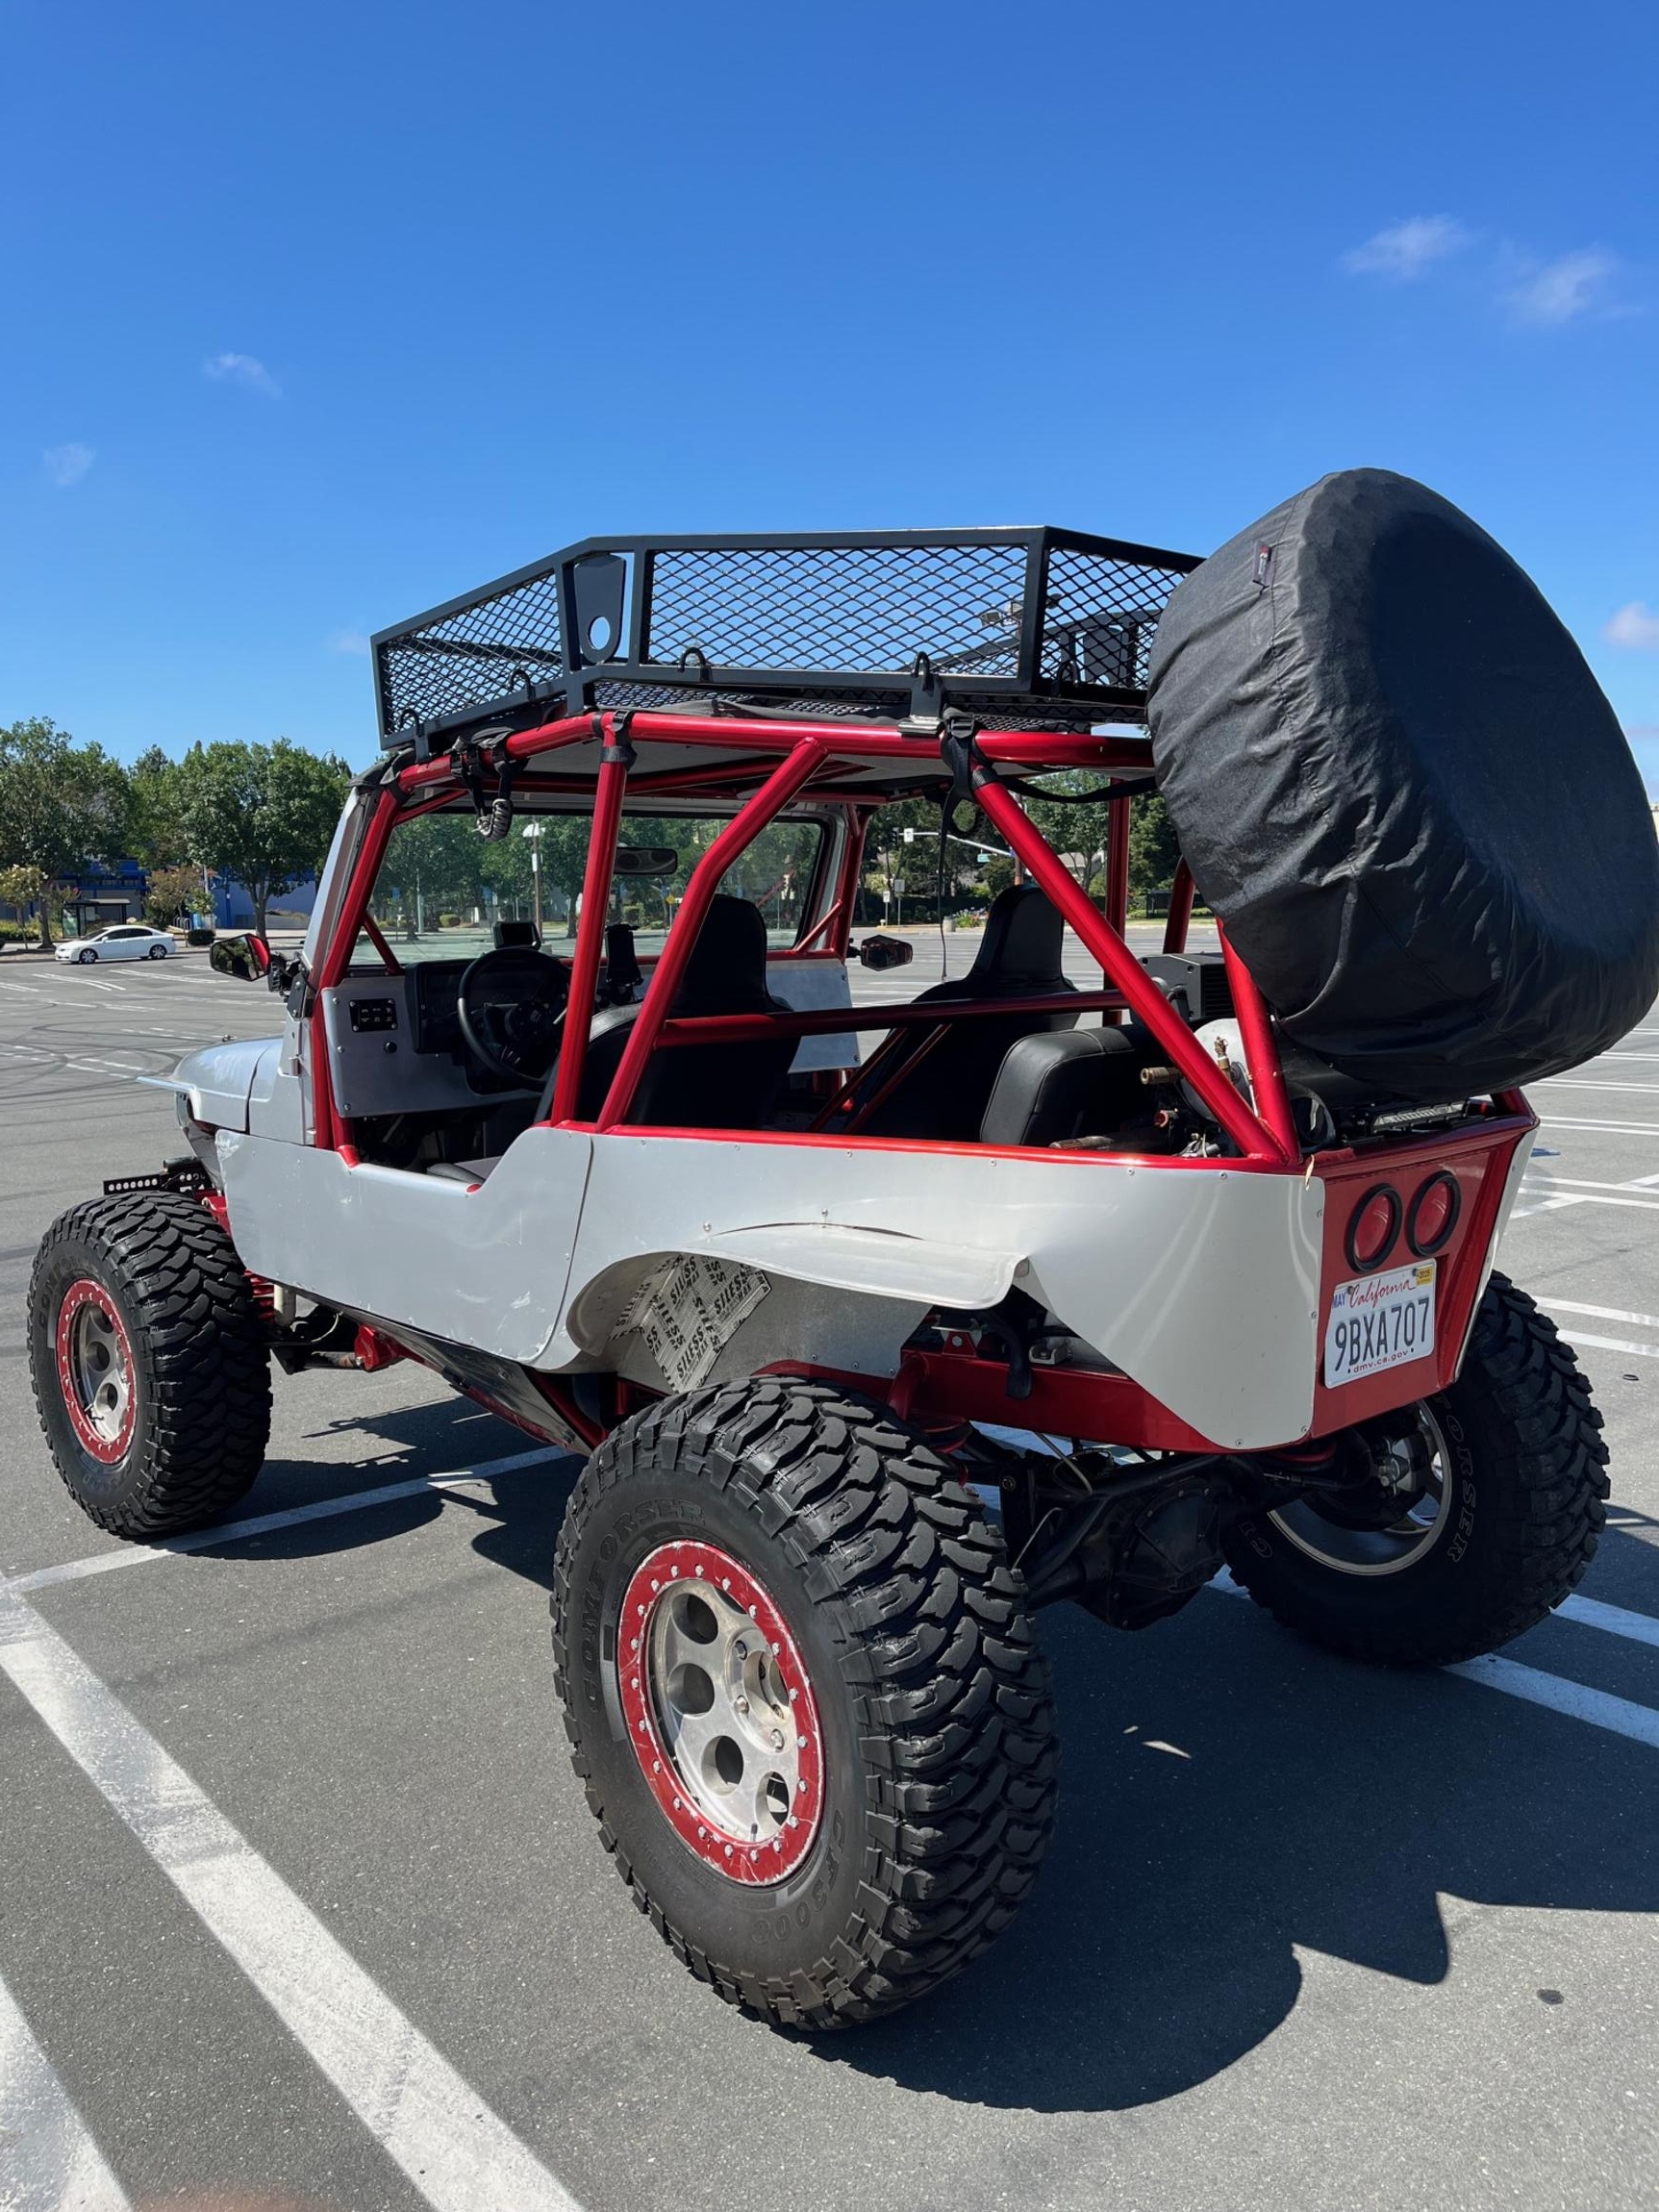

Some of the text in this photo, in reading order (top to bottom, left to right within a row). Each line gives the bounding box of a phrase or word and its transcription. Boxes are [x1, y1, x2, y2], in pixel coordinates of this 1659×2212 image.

[1333, 1292, 1346, 1309] MAY
[1348, 1277, 1416, 1309] California
[677, 1326, 704, 1378] SILESS
[1334, 1297, 1430, 1371] 9BXA707
[1353, 1348, 1409, 1373] dmv.ca.gov
[1436, 1393, 1477, 1563] FORSER
